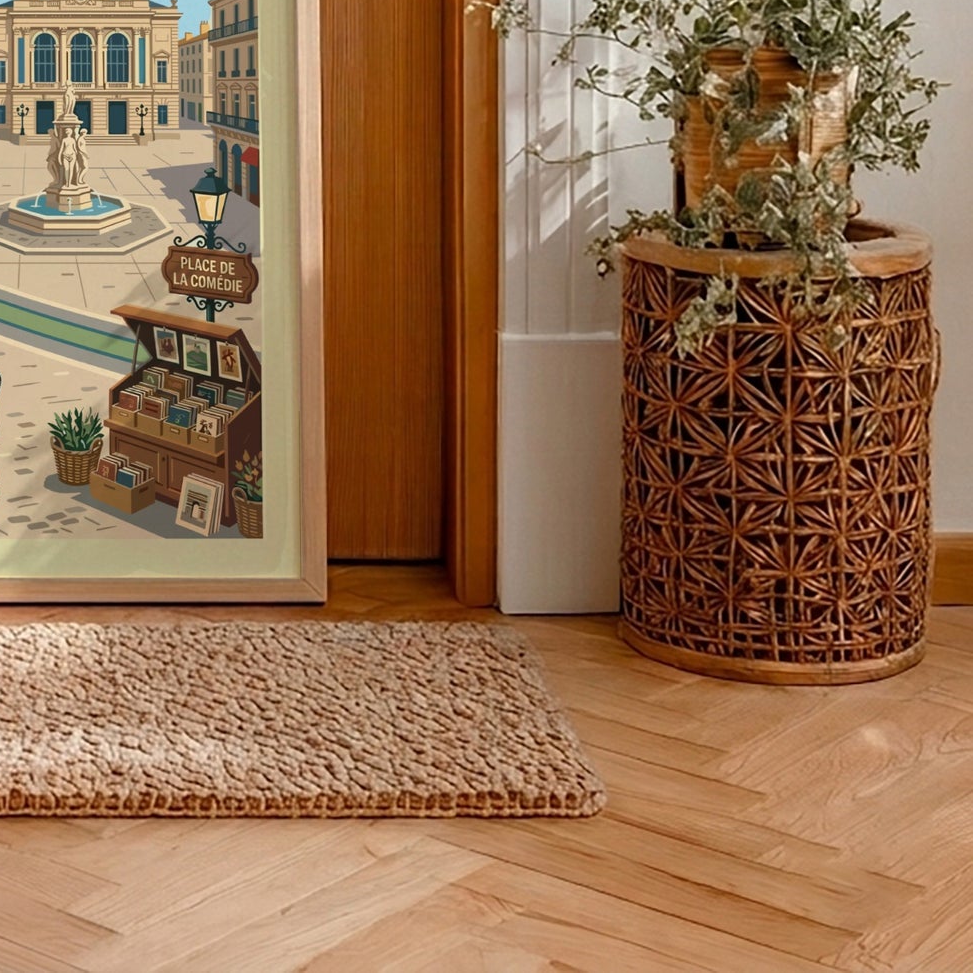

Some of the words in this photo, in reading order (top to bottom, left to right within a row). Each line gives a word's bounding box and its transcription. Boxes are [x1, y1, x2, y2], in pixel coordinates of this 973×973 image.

[180, 256, 217, 272] PLACE
[220, 261, 235, 275] DE
[173, 272, 188, 286] LA
[191, 274, 243, 292] COMÉDIE
